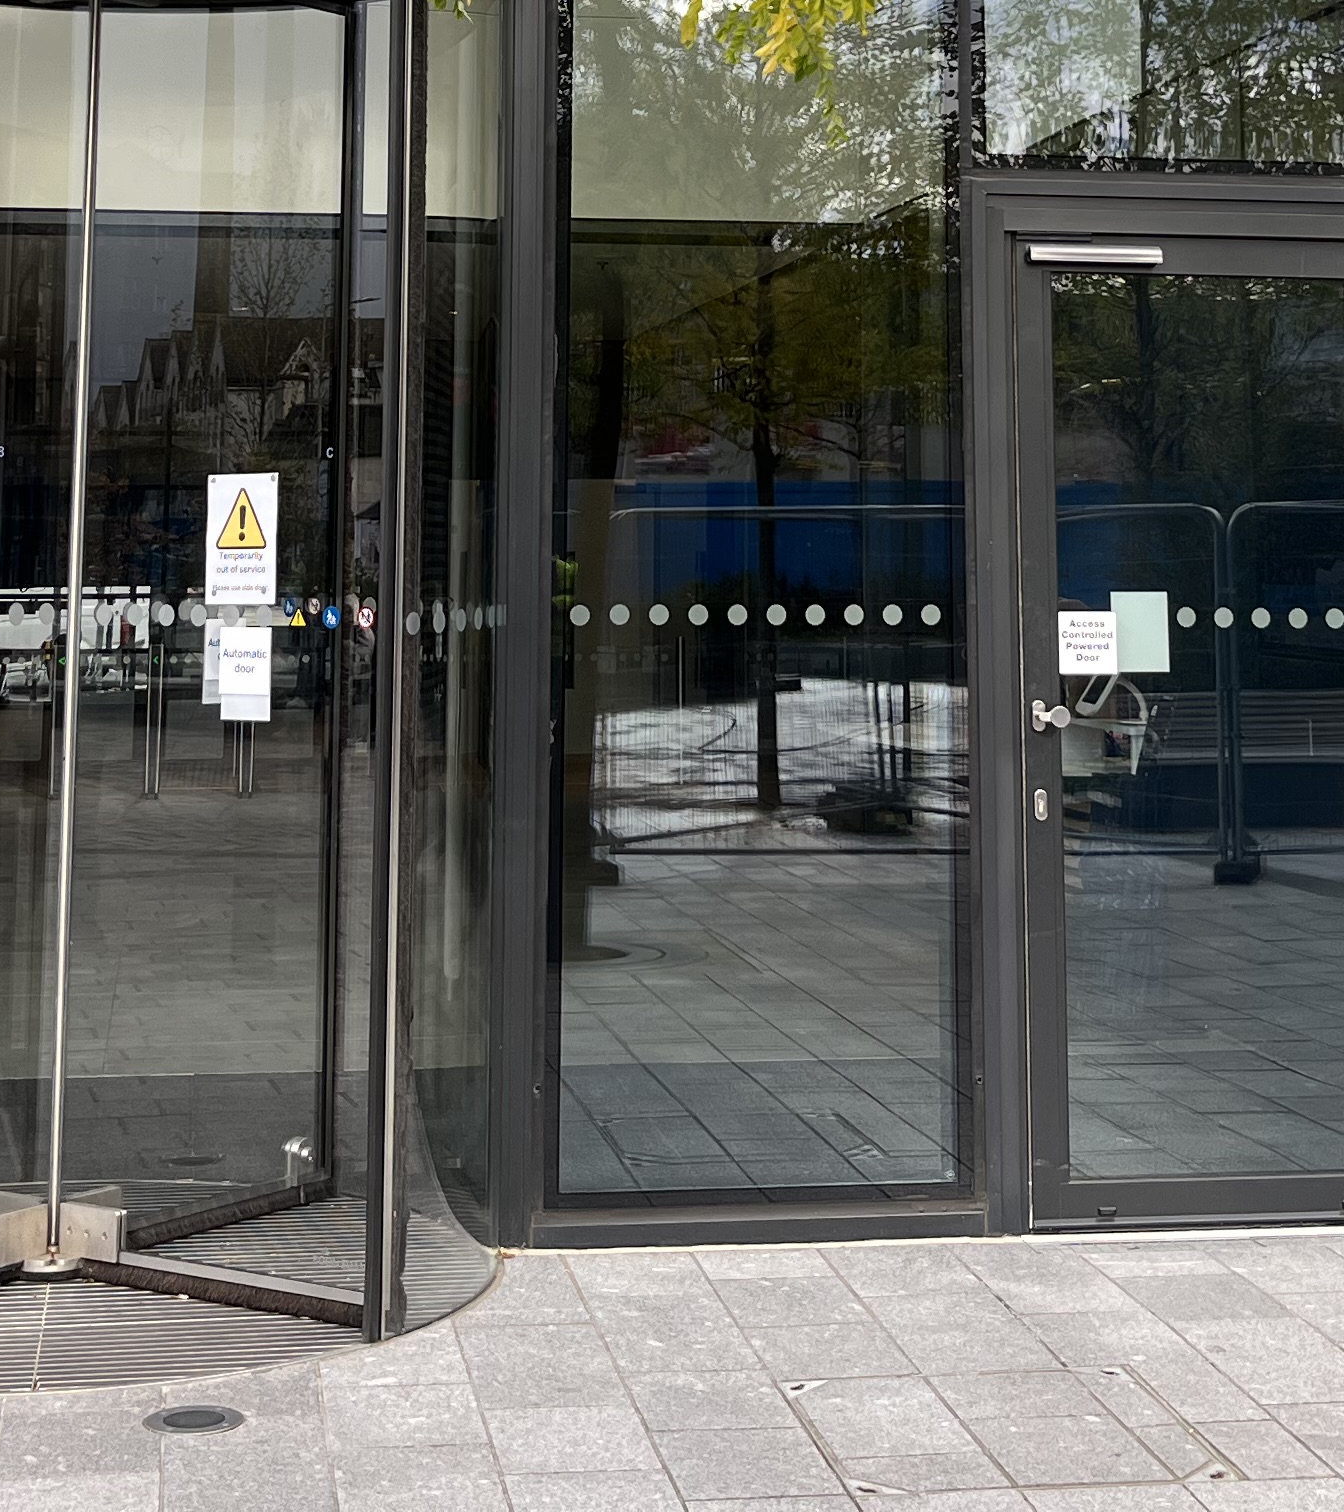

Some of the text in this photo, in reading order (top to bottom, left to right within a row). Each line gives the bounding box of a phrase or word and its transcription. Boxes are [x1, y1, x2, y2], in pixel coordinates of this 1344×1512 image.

[326, 447, 334, 458] C
[1069, 619, 1105, 628] Access
[1061, 630, 1114, 639] Controlled
[1066, 642, 1110, 650] Powered
[222, 648, 268, 659] Automatic
[1076, 653, 1101, 662] Door
[234, 663, 256, 674] door
